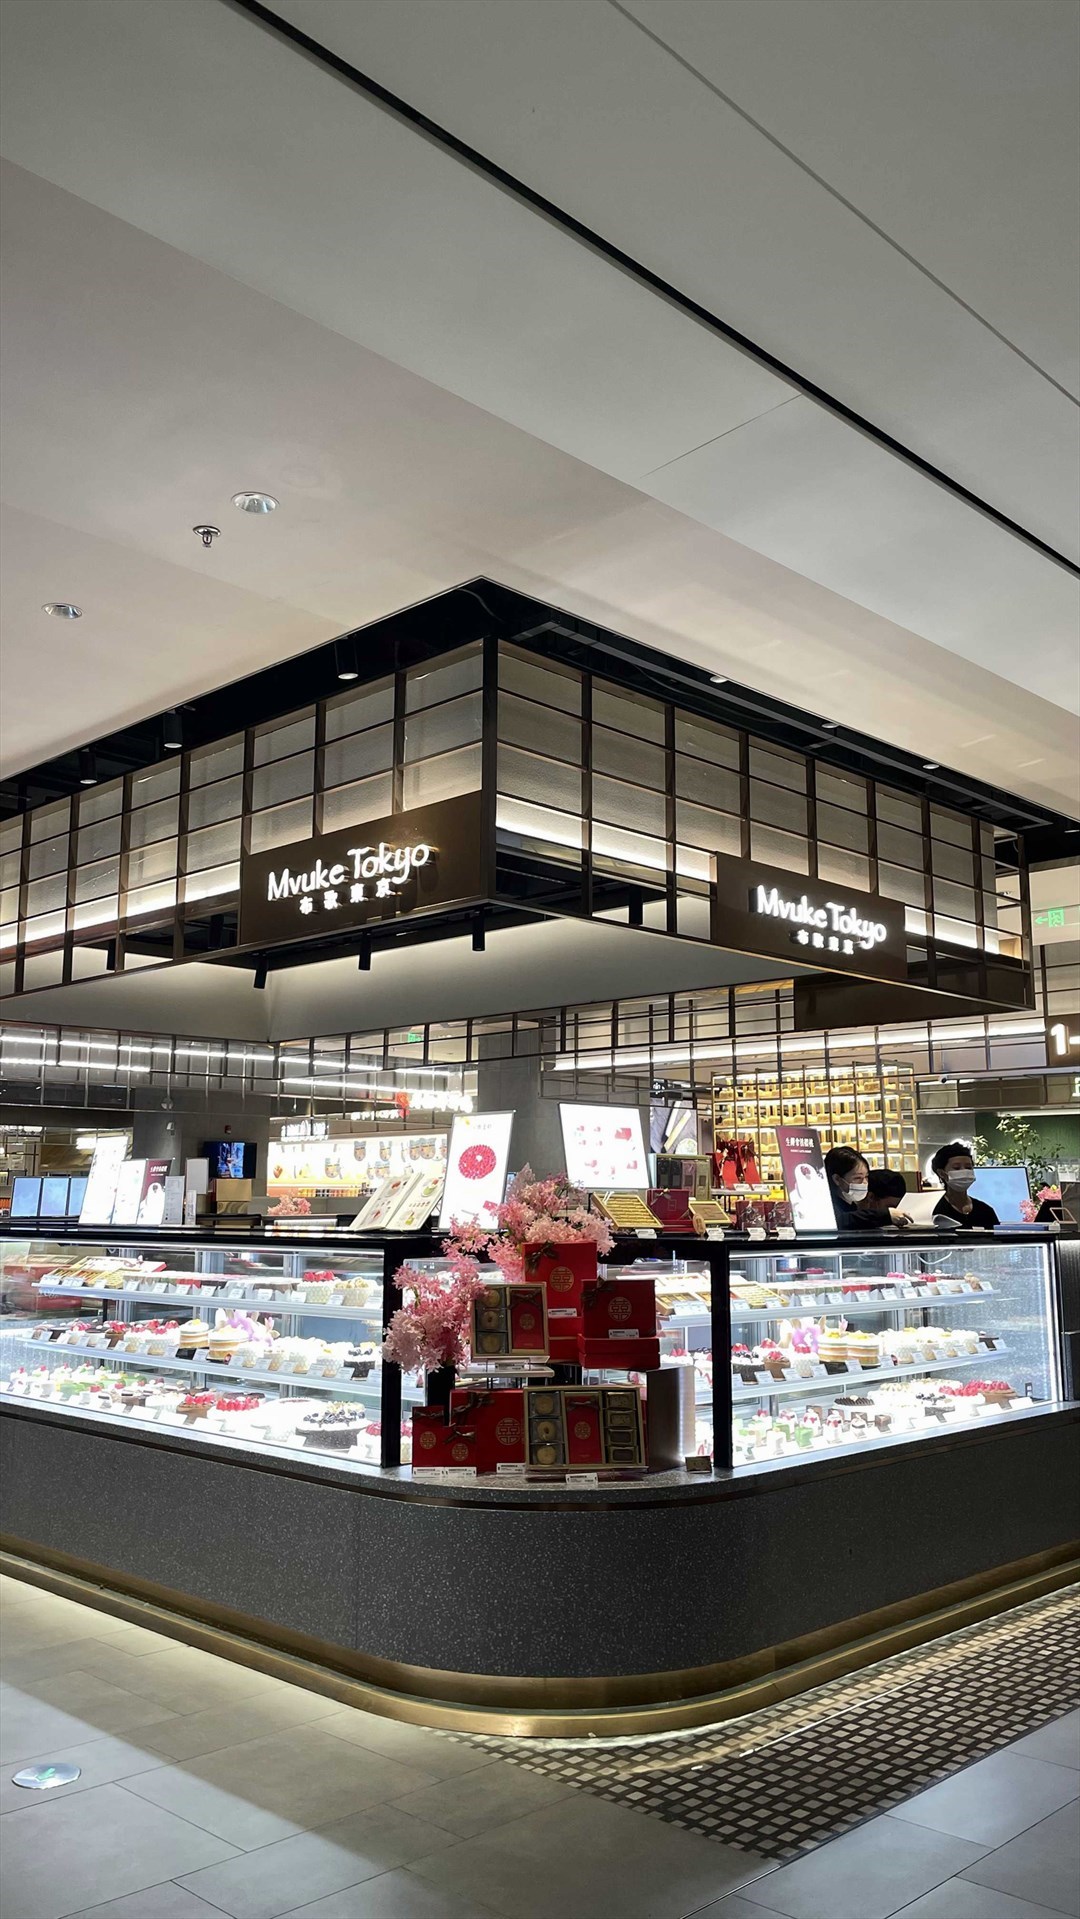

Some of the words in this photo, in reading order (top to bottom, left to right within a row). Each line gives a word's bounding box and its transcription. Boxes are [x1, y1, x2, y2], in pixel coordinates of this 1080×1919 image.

[268, 859, 345, 901] Mvuke
[347, 842, 430, 884] Tokyo
[757, 885, 828, 928] Mvuke
[826, 902, 887, 949] Tokyo
